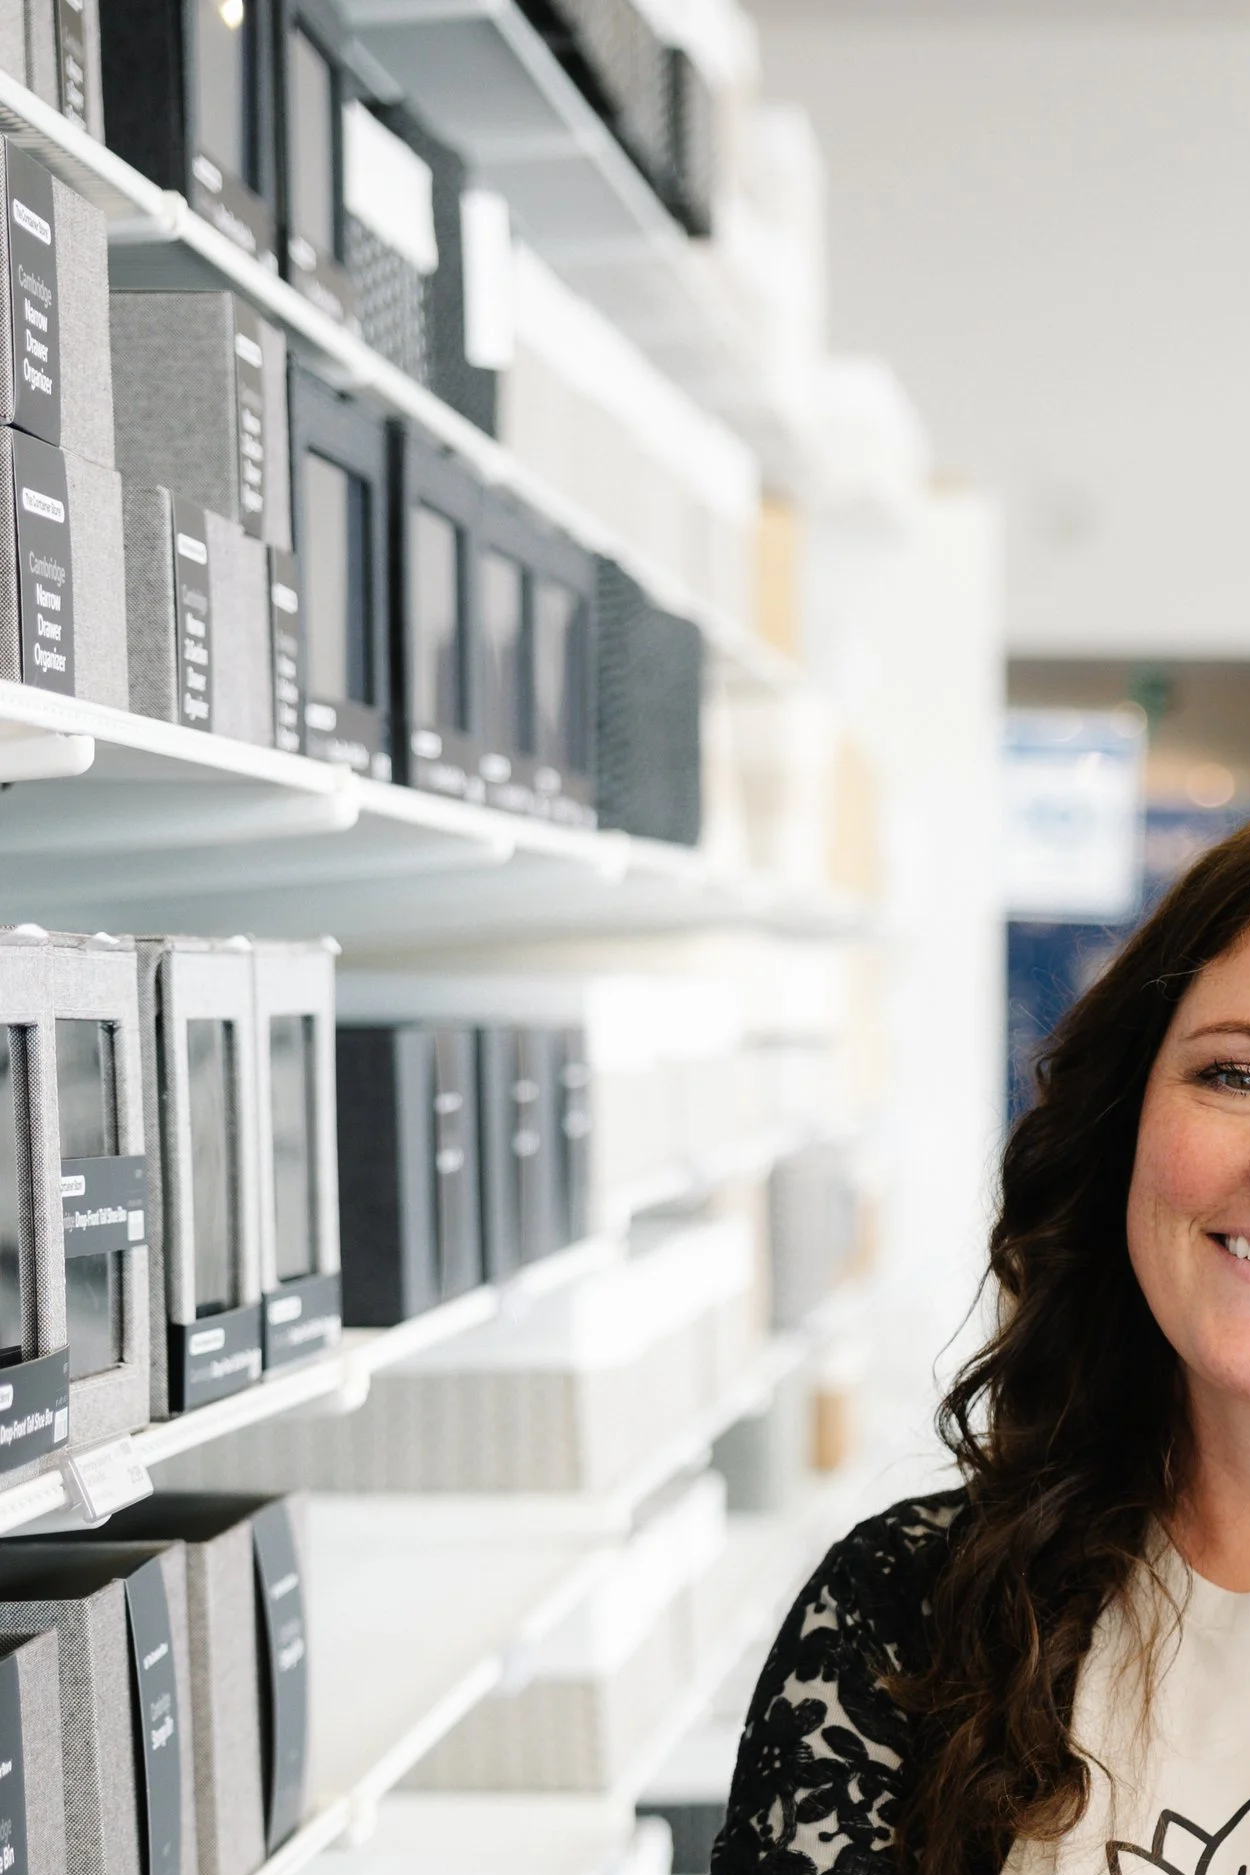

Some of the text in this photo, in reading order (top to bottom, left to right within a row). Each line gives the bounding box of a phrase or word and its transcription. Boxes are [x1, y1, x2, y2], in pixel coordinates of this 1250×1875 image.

[18, 264, 51, 308] Cambridge
[25, 297, 48, 332] Narrow
[26, 328, 49, 363] Drawer
[23, 357, 52, 395] Organizer
[29, 551, 66, 588] Cambridge
[36, 582, 61, 612] Narrow
[37, 612, 62, 641] Drawer
[34, 642, 66, 673] Organizer
[45, 1407, 54, 1427] Box
[4, 1843, 15, 1870] Bin
